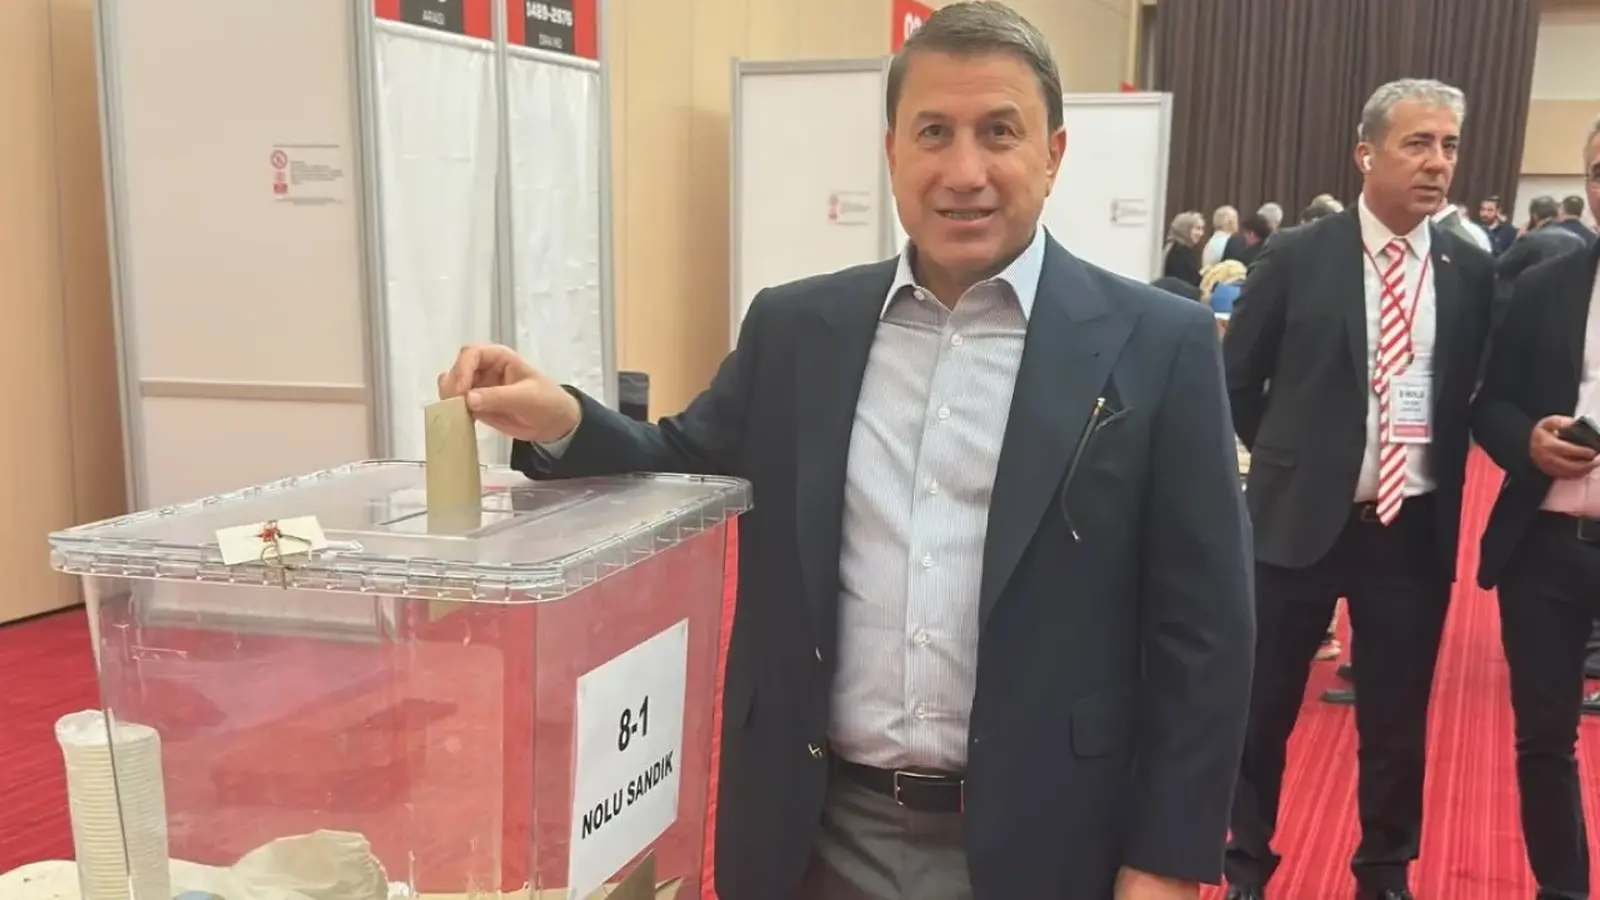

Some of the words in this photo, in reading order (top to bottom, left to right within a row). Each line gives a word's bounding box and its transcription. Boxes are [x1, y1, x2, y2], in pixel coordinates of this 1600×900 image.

[618, 695, 649, 751] 8-1
[581, 788, 624, 840] NOLU
[626, 750, 674, 806] SANDIK
